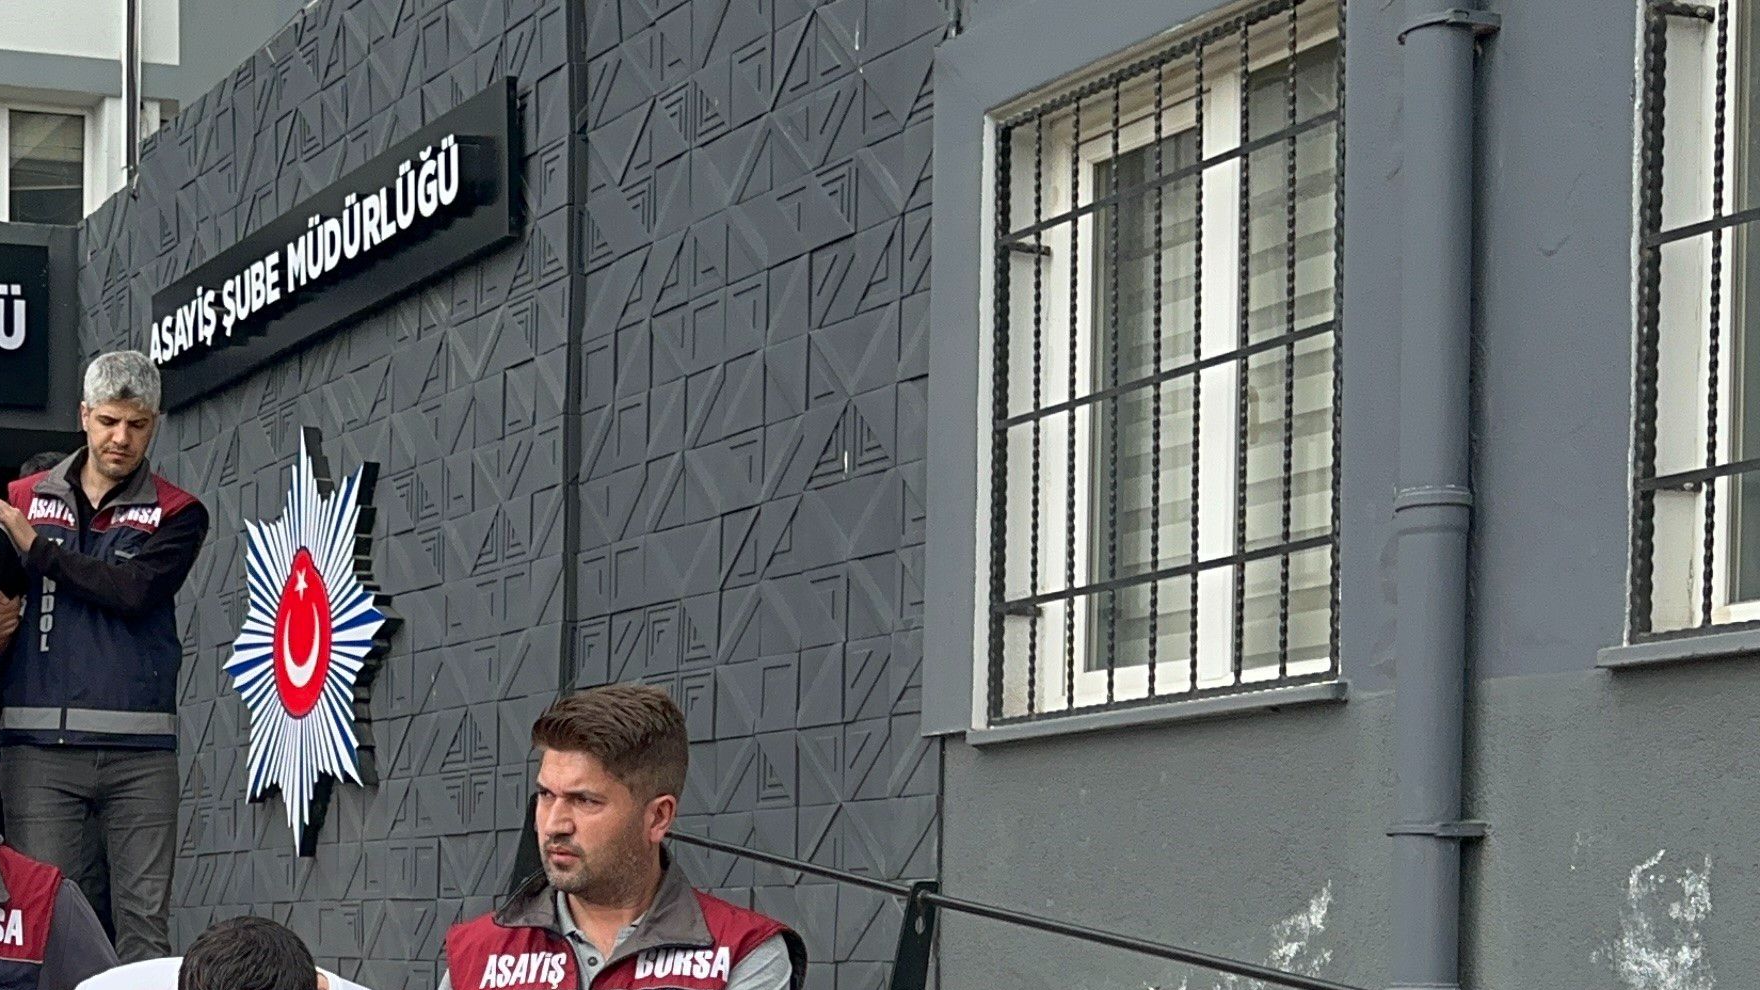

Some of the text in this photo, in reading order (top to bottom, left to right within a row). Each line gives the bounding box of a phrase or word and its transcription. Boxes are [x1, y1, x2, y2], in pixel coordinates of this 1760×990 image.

[149, 133, 460, 365] ASAYİŞ ŞUBE MÜDÜRLÜĞÜ
[478, 951, 567, 990] ASAYİŞ
[634, 946, 730, 983] BURSA
